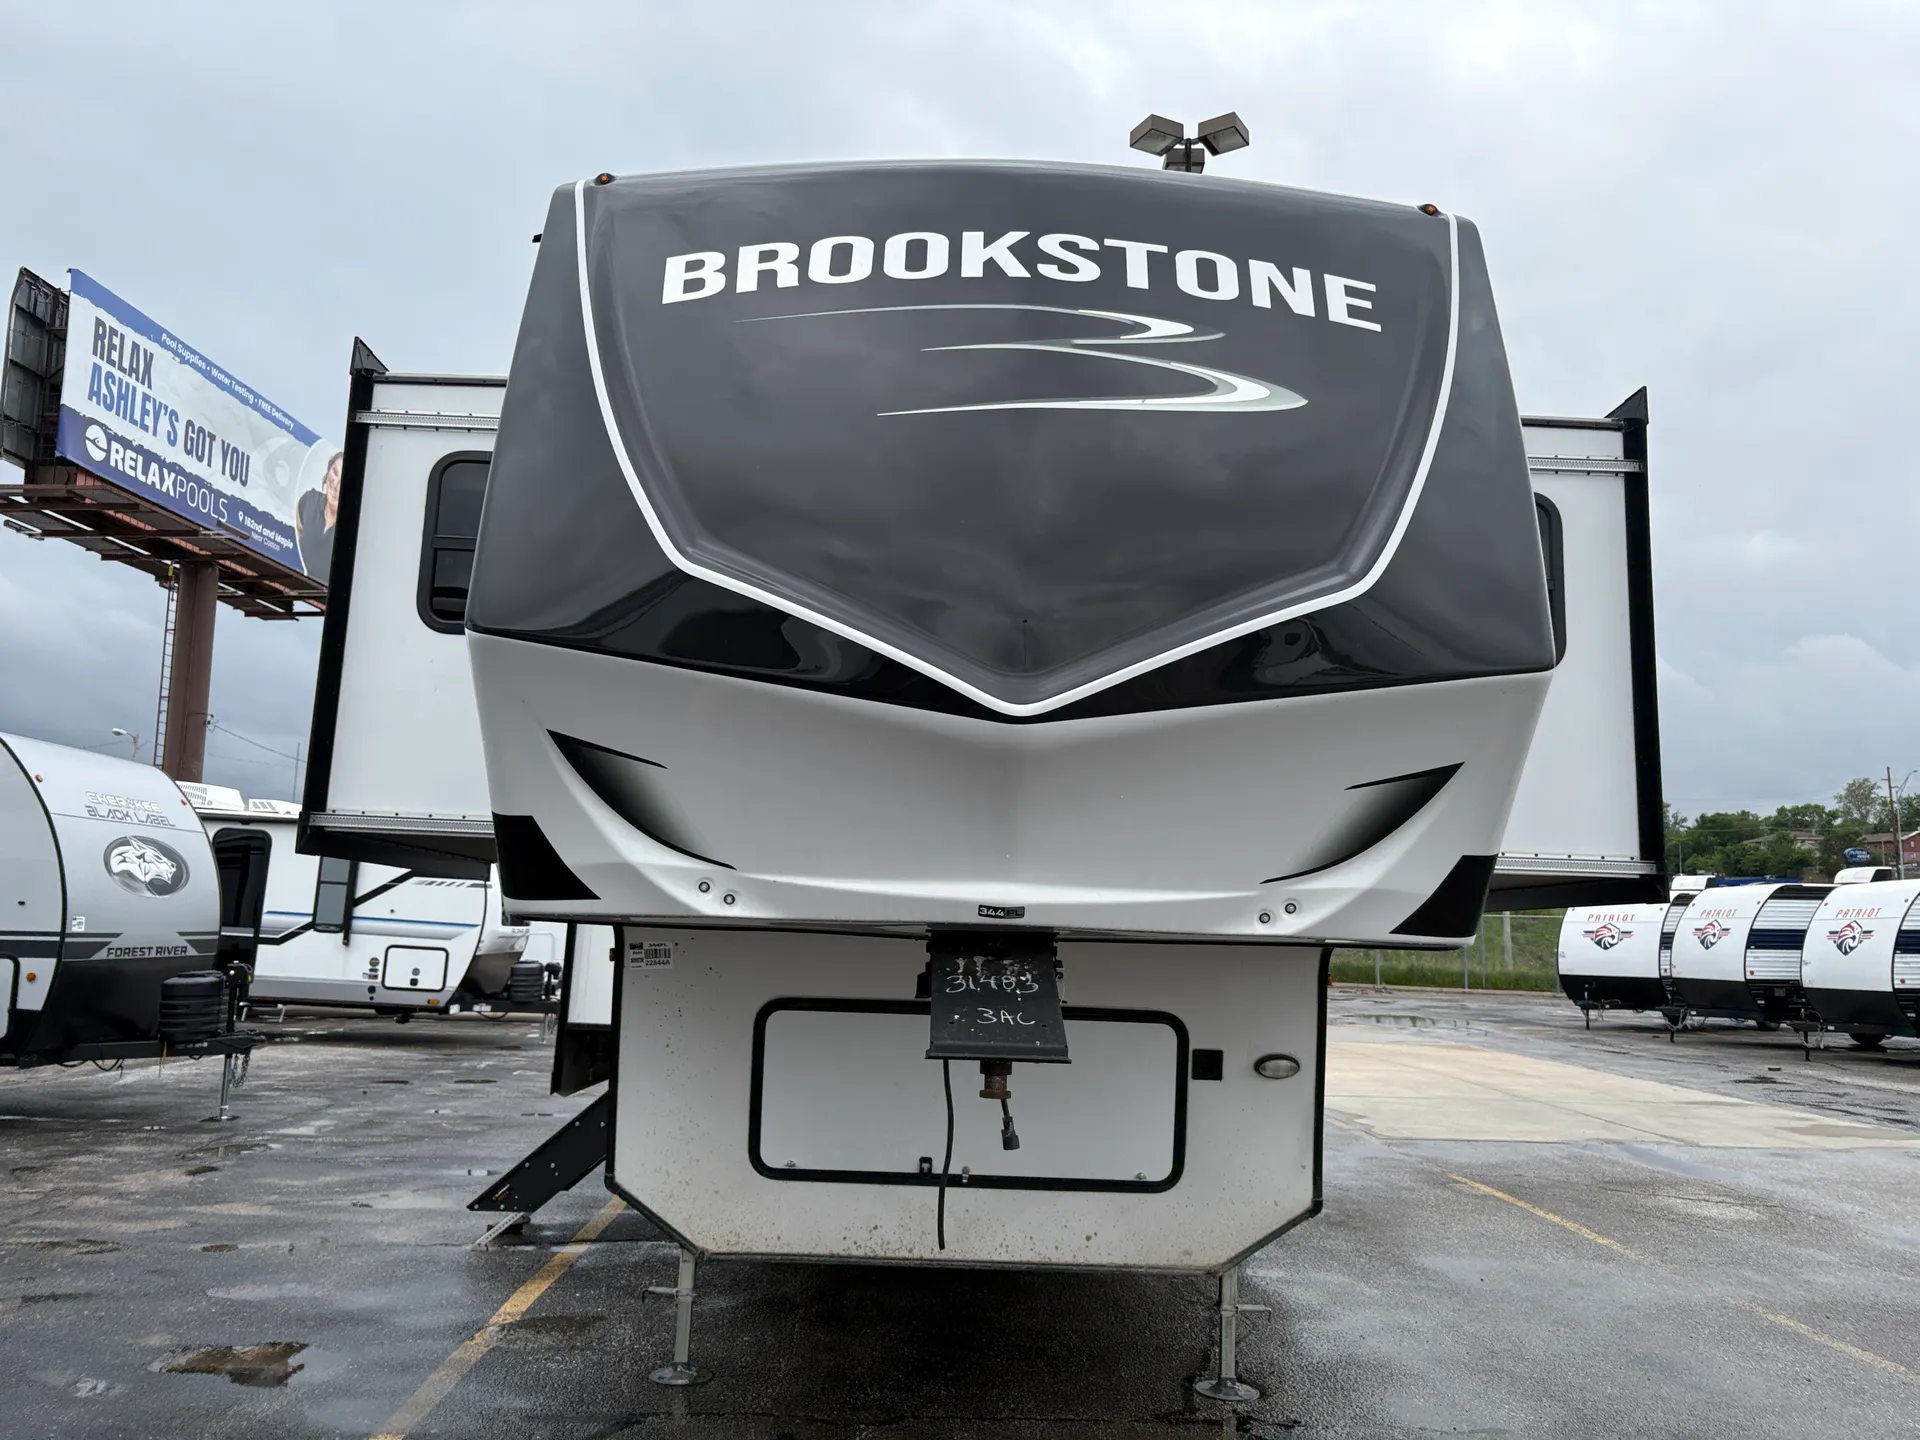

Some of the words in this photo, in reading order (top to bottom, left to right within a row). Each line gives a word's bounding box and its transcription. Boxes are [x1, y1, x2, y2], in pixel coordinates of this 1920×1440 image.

[661, 231, 1382, 333] BROOKSTONE
[92, 316, 154, 390] RELAX
[161, 332, 178, 351] Pool
[177, 344, 206, 370] Supplies
[211, 366, 231, 387] Water
[231, 380, 255, 404] Testing
[258, 399, 272, 414] FREE
[271, 408, 295, 431] Delivery
[87, 361, 180, 447] ASHLEY'S
[183, 419, 217, 468] GOT
[221, 438, 250, 487] YOU
[85, 791, 163, 813] CHEROKEE
[85, 805, 133, 821] BLACK
[133, 811, 176, 827] LABEL
[979, 907, 1004, 917] 344
[1587, 913, 1636, 922] PATRIOT
[1700, 908, 1737, 918] PATRIOT
[1835, 907, 1882, 918] PATRIOT
[106, 947, 154, 958] FOREST
[155, 945, 189, 956] RIVER
[976, 1007, 1036, 1026] 3AC
